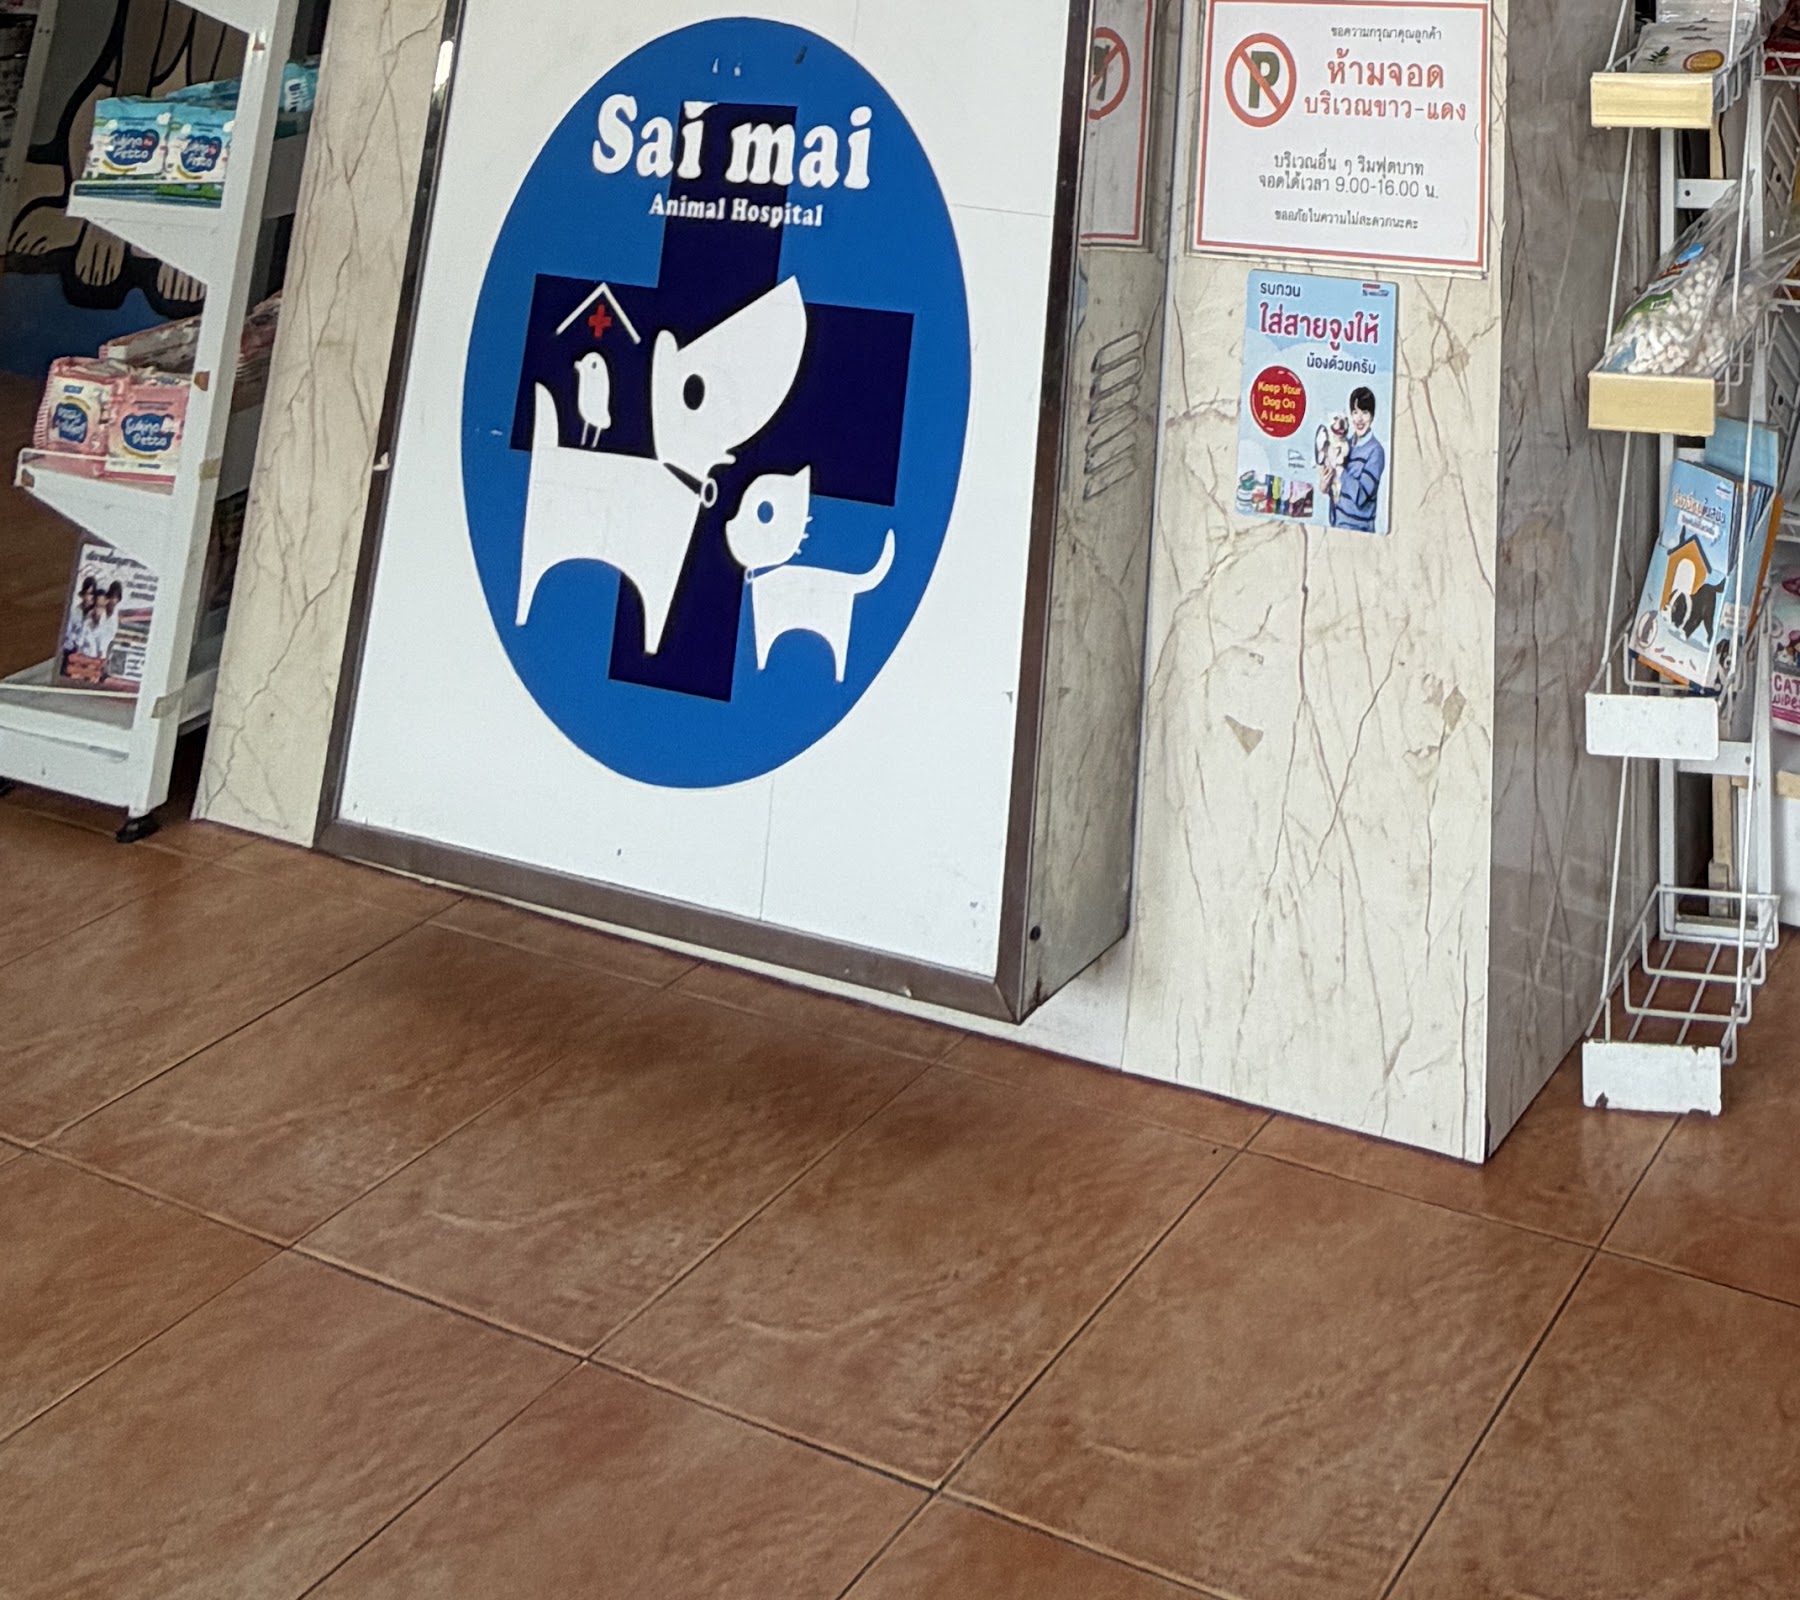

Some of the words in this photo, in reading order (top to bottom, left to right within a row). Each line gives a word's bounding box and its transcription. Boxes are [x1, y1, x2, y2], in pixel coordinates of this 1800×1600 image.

[1331, 26, 1442, 43] ขอความกรุณาคุณลูกค้า
[1327, 48, 1444, 89] ห้ามจอด
[1304, 89, 1466, 121] บริเวณขาว-แดง
[590, 92, 719, 180] Sai
[725, 105, 874, 191] mai
[1274, 148, 1337, 171] บริเวณอื่น
[1357, 155, 1425, 179] ริมฟุตบาท
[1259, 170, 1330, 191] จอดได้เวลา
[1335, 176, 1420, 197] 9.00-16.00
[1425, 184, 1439, 199] น.
[648, 192, 727, 223] Animal
[730, 197, 825, 229] Hospital
[1274, 208, 1419, 230] ขออภัยในความไม่สะดวกนะคะ
[1260, 282, 1301, 298] รบกวน
[1259, 302, 1380, 350] ใส่สายจูงให้
[1306, 352, 1376, 375] น้องด้วยครับ
[1258, 381, 1280, 394] Keep
[1282, 384, 1302, 395] Your
[1262, 396, 1280, 409] Dog
[1282, 398, 1296, 410] On
[1261, 410, 1268, 420] A
[1270, 410, 1296, 424] Leash
